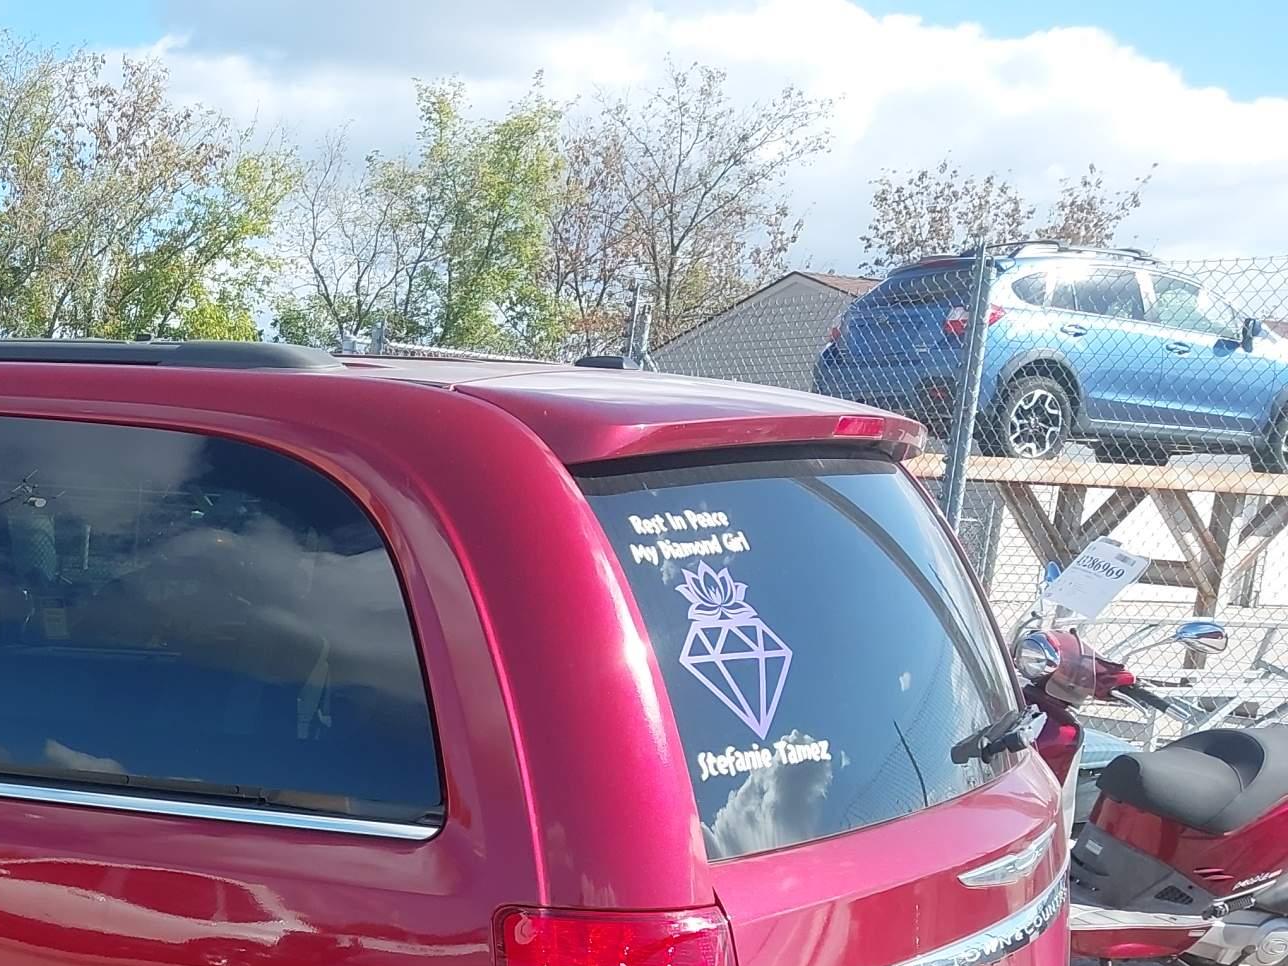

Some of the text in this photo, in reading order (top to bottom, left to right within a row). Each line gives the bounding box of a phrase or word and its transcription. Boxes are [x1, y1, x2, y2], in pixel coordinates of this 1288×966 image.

[628, 514, 668, 535] Rest
[683, 509, 730, 530] Peace
[629, 531, 750, 566] My Diamond Girl
[697, 739, 832, 782] Stefanie Tamez
